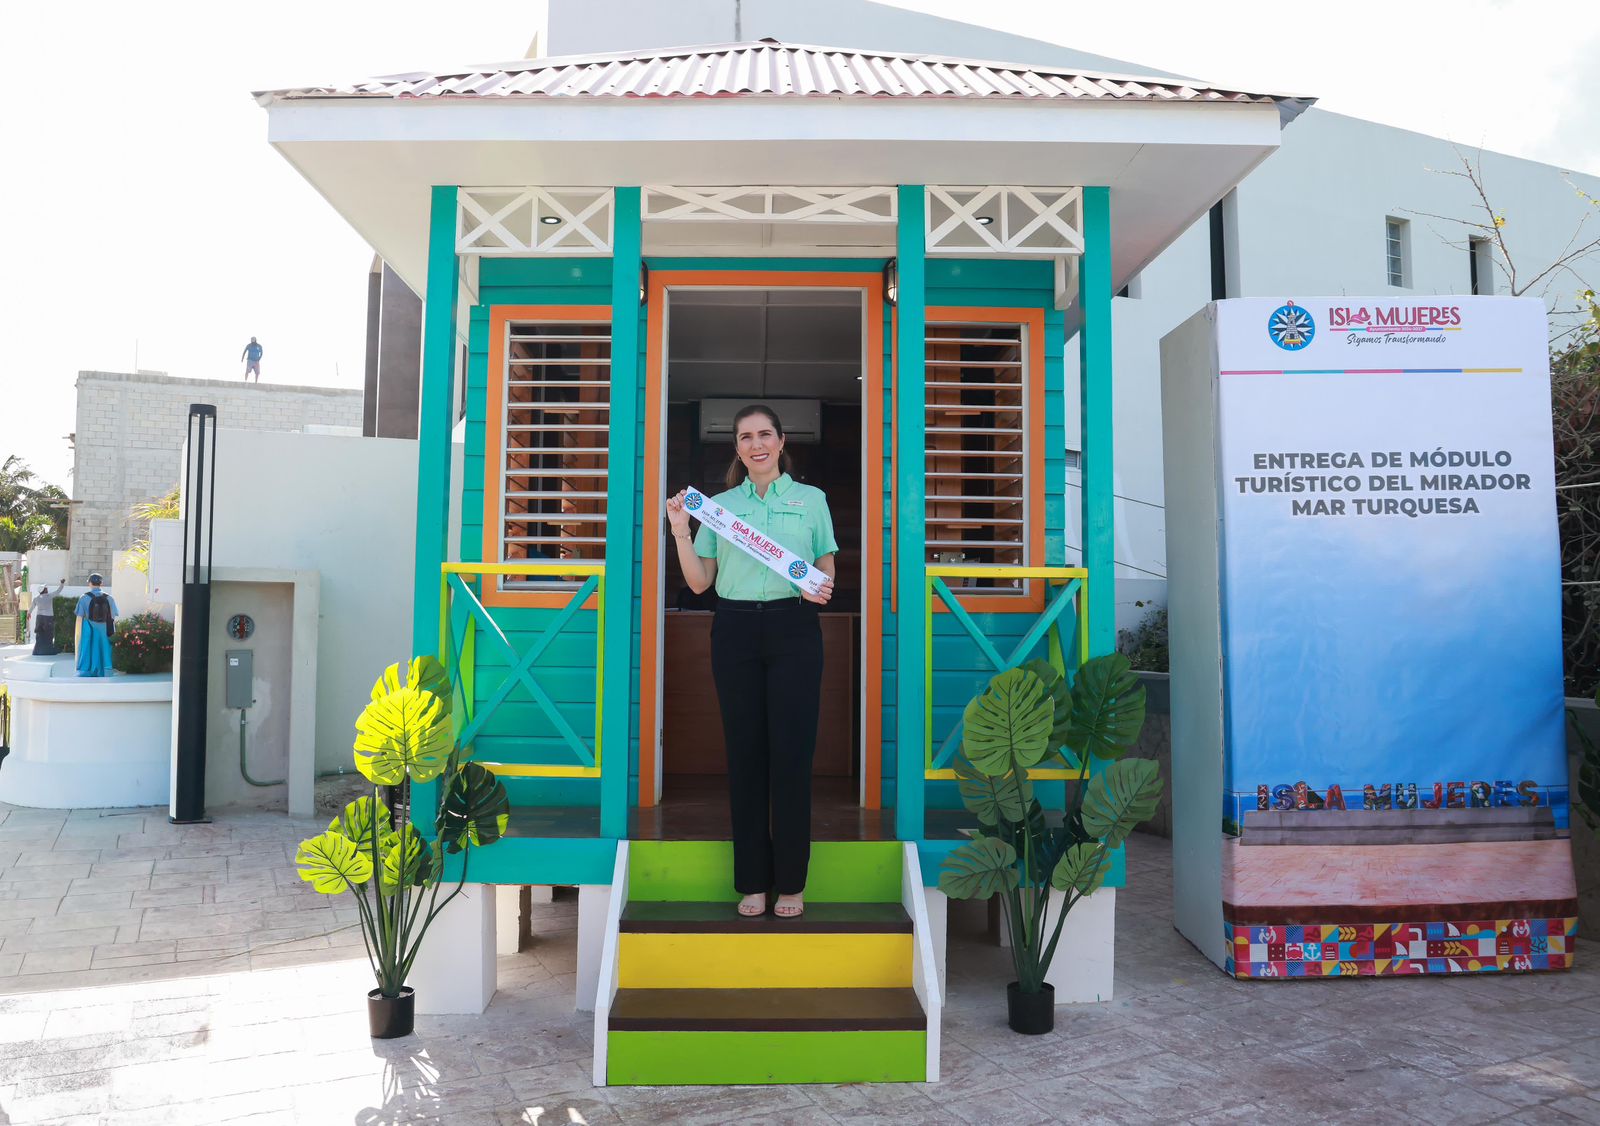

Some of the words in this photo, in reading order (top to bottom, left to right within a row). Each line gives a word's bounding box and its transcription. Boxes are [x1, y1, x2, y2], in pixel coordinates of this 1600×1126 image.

[1329, 307, 1372, 326] ISLA
[1375, 306, 1461, 326] MUJERES
[1346, 333, 1382, 347] Sigamos
[1383, 332, 1447, 344] Transformando
[1254, 452, 1364, 469] ENTREGA
[1371, 451, 1402, 468] DE
[1410, 447, 1512, 468] MÓDULO
[1235, 472, 1361, 493] TURÍSTICO
[1369, 475, 1413, 491] DEL
[1420, 473, 1531, 491] MIRADOR
[1292, 499, 1345, 516] MAR
[1352, 497, 1480, 518] TURQUESA
[731, 520, 750, 537] ISLA
[749, 530, 785, 560] MUJERES
[1257, 780, 1347, 811] ISLA
[1363, 780, 1540, 811] MUJERES
